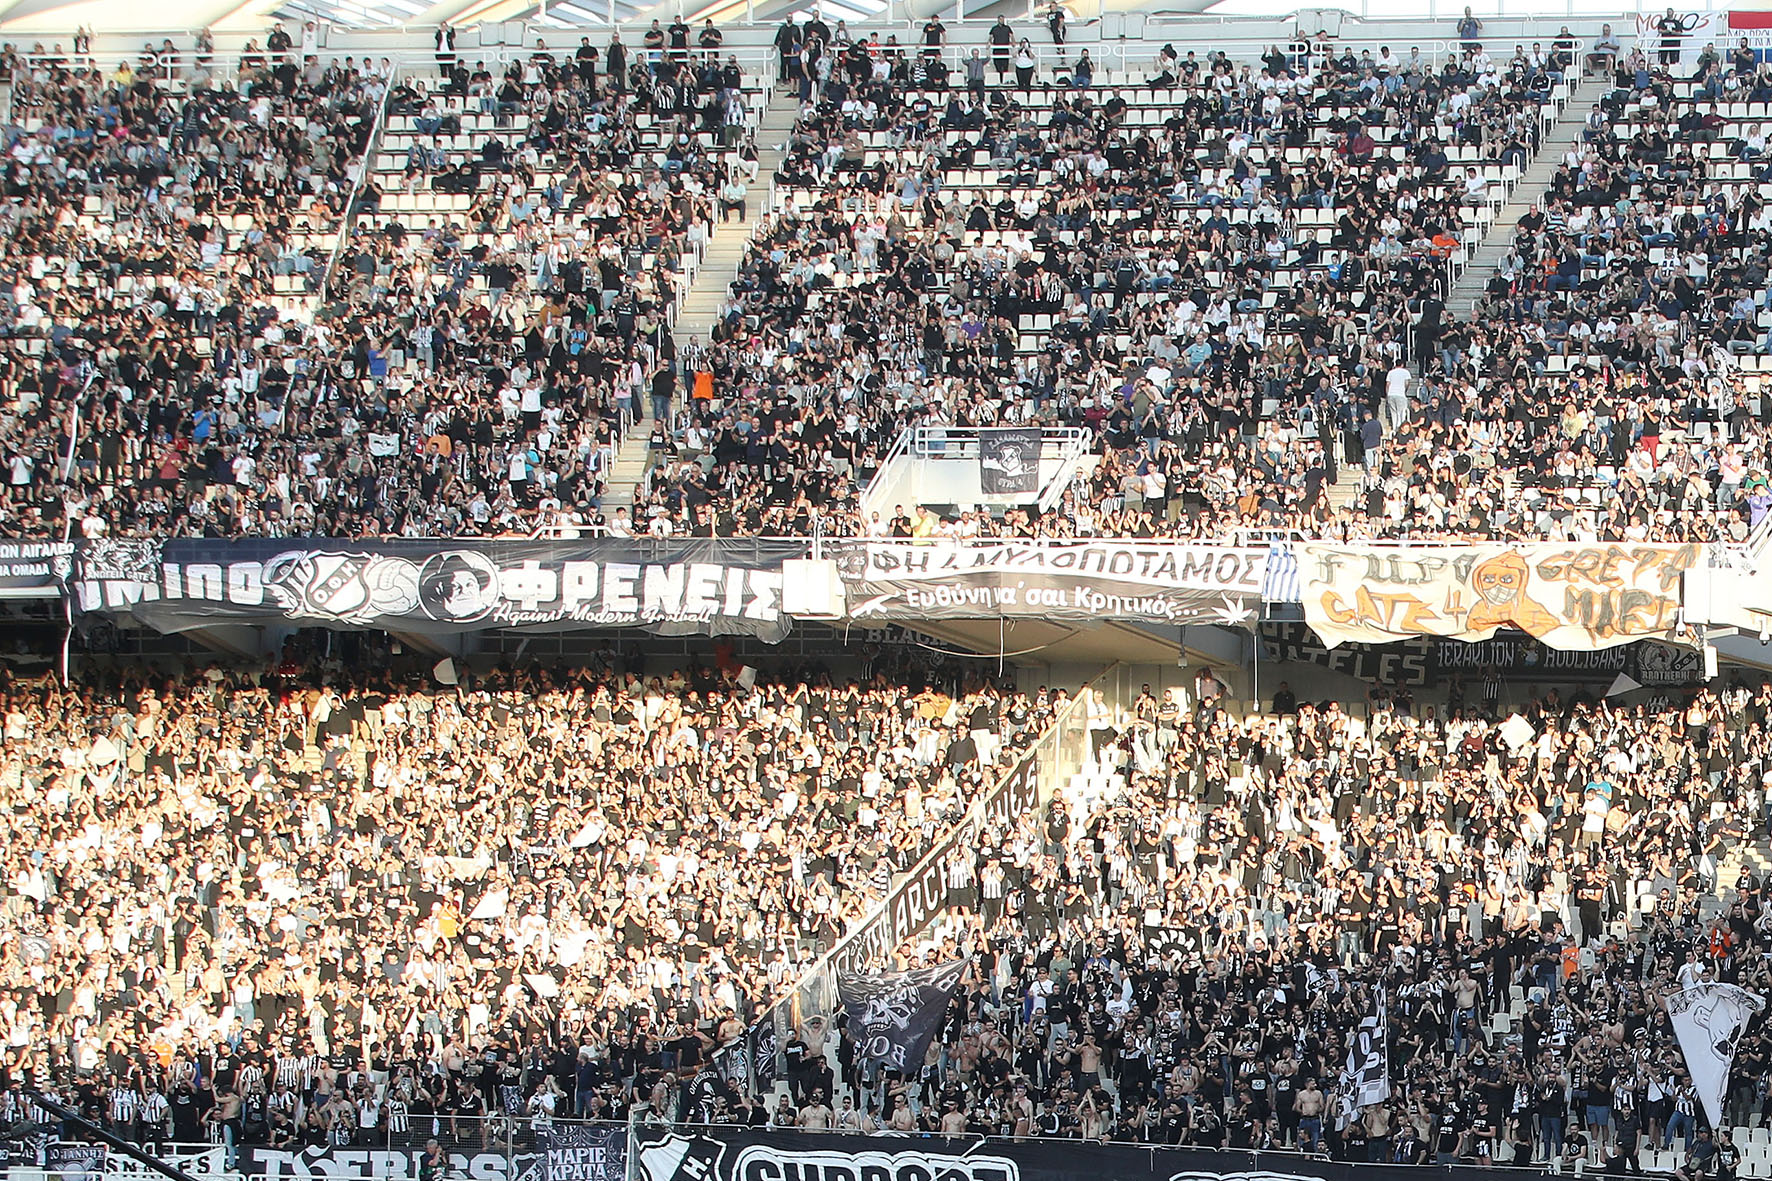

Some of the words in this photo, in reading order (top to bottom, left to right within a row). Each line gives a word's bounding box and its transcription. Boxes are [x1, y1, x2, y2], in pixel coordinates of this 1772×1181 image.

[23, 543, 75, 558] ΑΙΓΑΛΕΩ
[11, 564, 50, 576] ΟΜΑΔΑ
[501, 559, 784, 621] ΦΡΕΝΕΙΣ
[906, 585, 992, 610] Ευθύνη
[1025, 588, 1068, 607] σαι
[493, 600, 566, 626] Against
[567, 602, 637, 624] Modern
[1319, 585, 1441, 634] GATE
[1443, 585, 1468, 630] 4
[1543, 646, 1627, 672] HOOLIGANS
[547, 1148, 606, 1166] ΜΑΡΙΕ
[549, 1163, 607, 1181] ΚΡΑΤΑ
